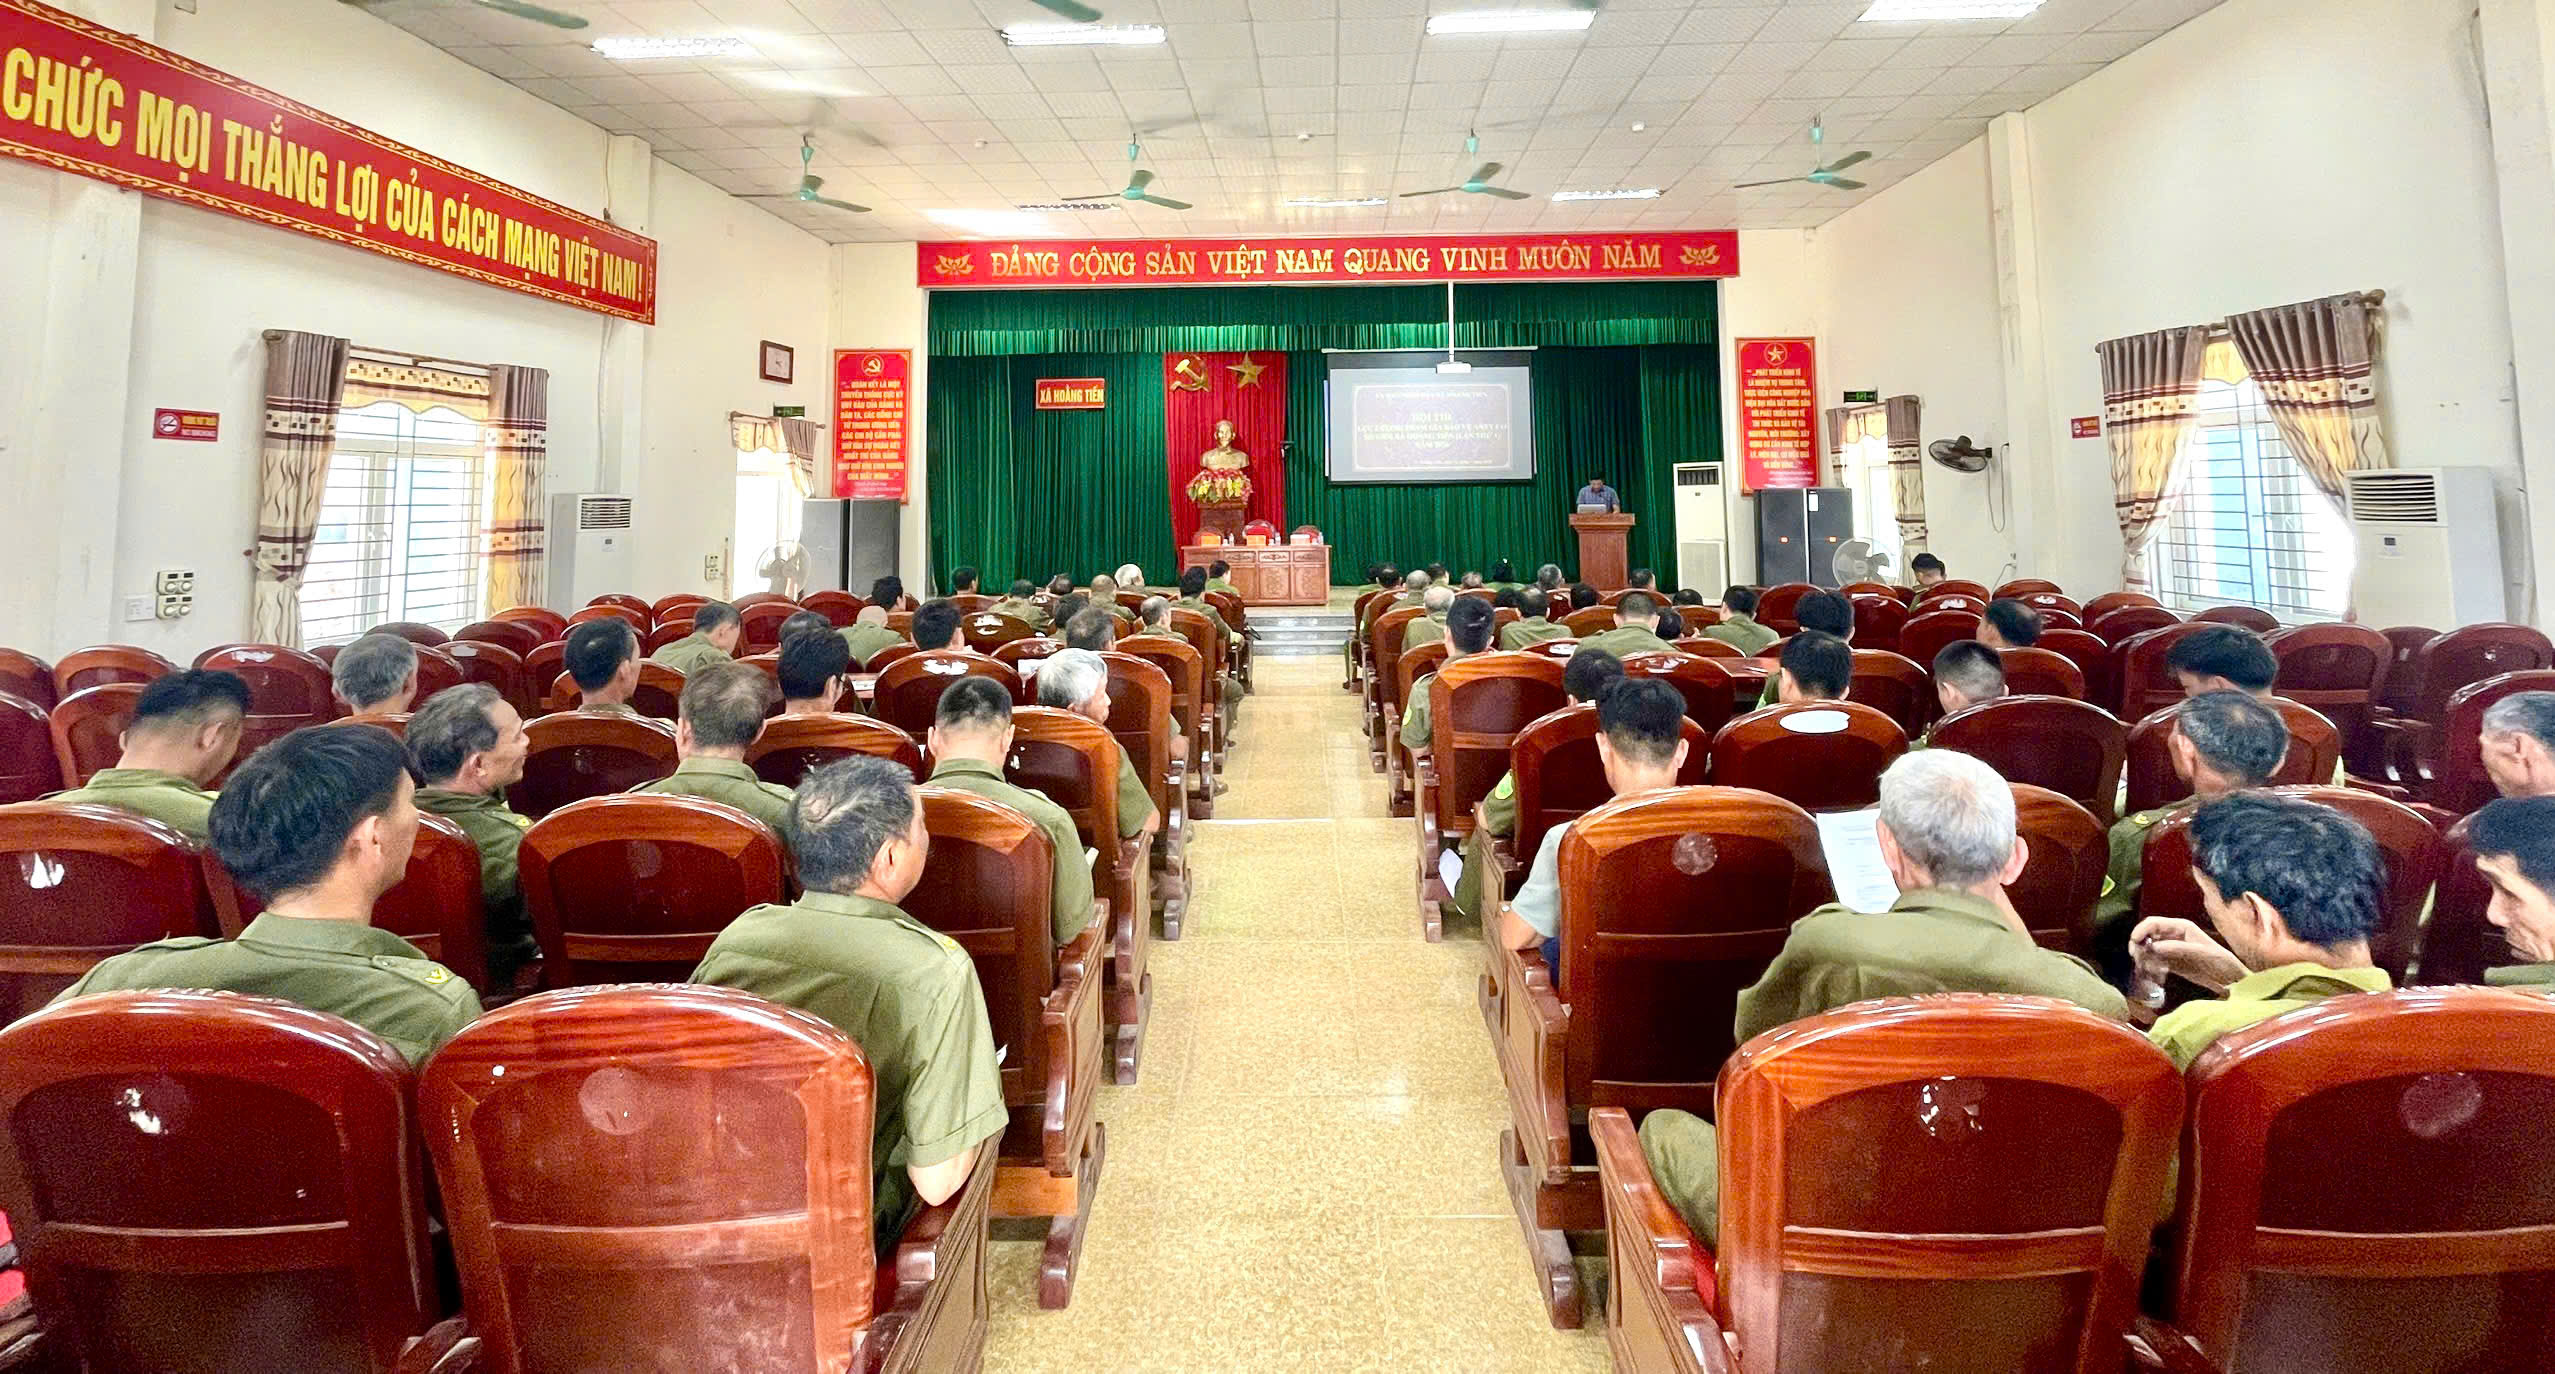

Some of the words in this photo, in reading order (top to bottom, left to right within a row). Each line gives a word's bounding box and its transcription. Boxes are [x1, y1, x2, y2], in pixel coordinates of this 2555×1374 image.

[3, 47, 125, 147] CHỨC
[136, 90, 212, 183] MỌI
[222, 114, 328, 209] THẮNG
[336, 160, 379, 233] LỢI
[386, 168, 434, 241] CỦA
[441, 192, 499, 260] CÁCH
[504, 218, 560, 280] MẠNG
[565, 236, 599, 296] VIỆT
[990, 245, 1059, 277] ĐẢNG
[1069, 246, 1136, 281] CỘNG
[1145, 243, 1196, 275] SẢN
[1207, 244, 1267, 279] VIỆT
[1276, 248, 1334, 274] NAM
[1343, 247, 1430, 275] QUANG
[1440, 248, 1508, 272] VINH
[1518, 240, 1591, 271] MUÔN
[1602, 241, 1663, 270] NĂM
[1040, 386, 1052, 404] XÃ
[1085, 385, 1105, 403] TIẾN
